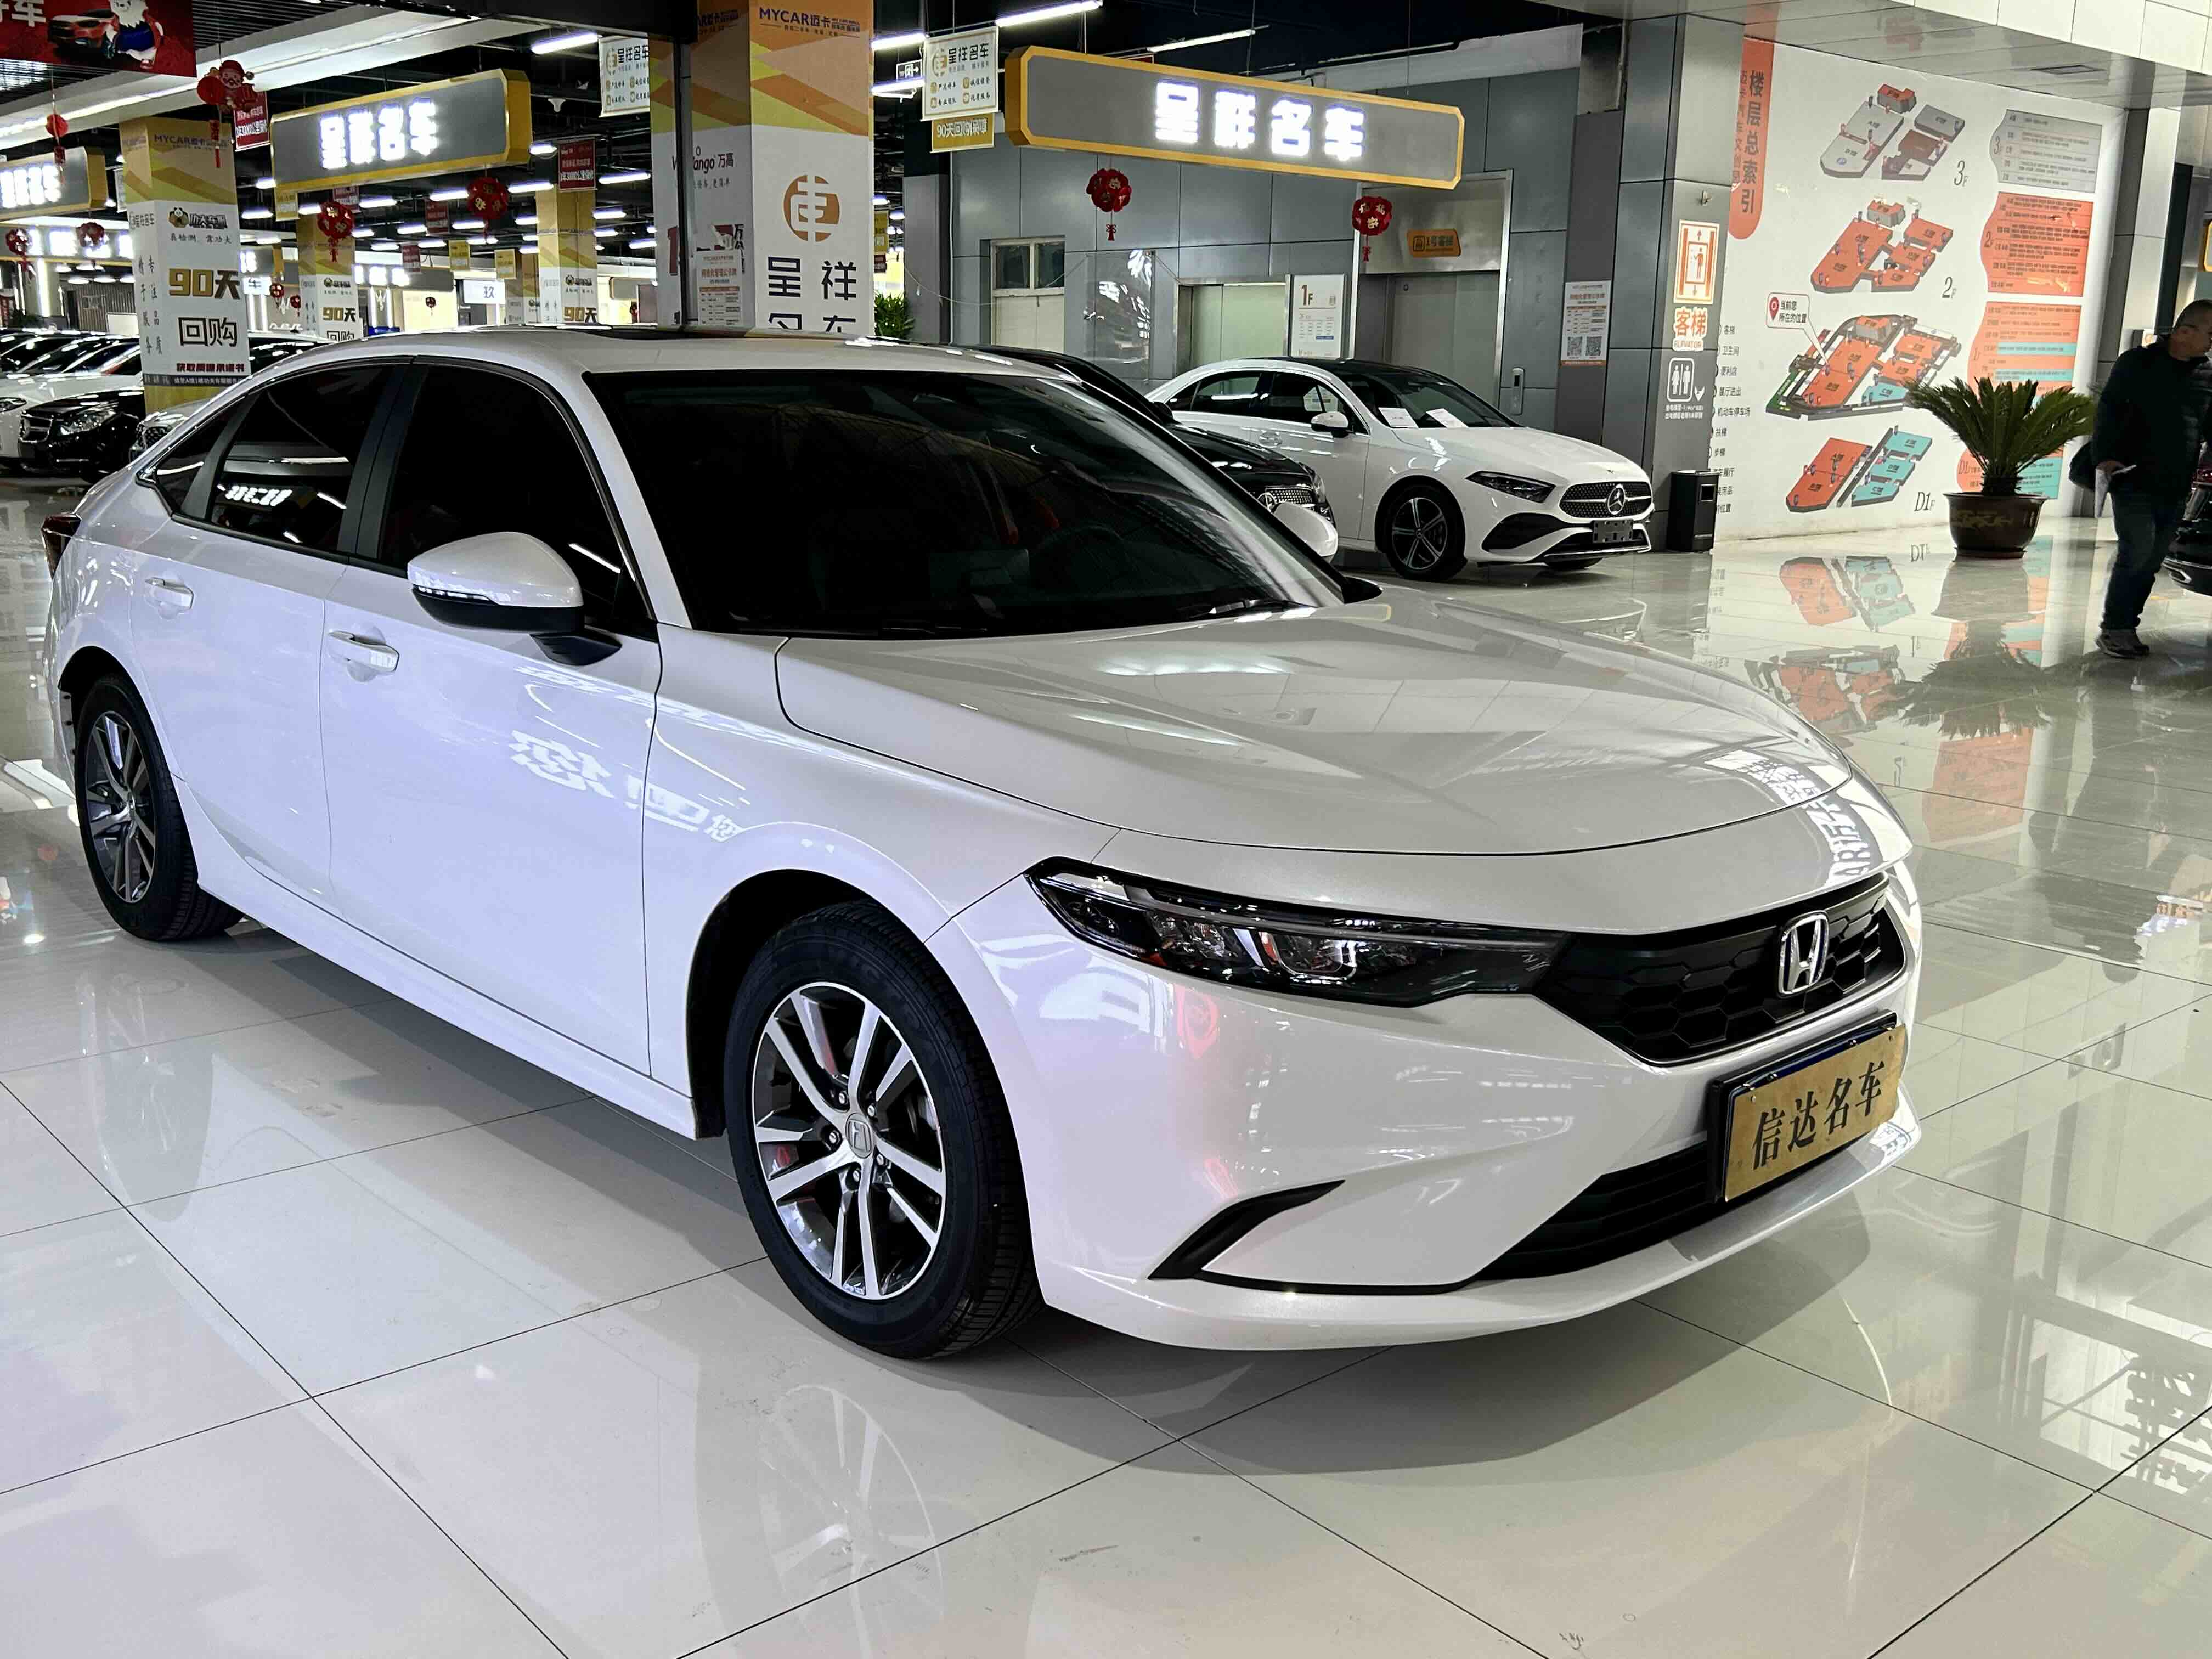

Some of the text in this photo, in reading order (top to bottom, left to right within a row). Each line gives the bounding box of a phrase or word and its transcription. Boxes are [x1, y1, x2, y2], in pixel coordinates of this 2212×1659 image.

[0, 0, 46, 27] 车
[949, 43, 989, 64] 呈祥名车
[1741, 70, 1765, 215] 楼层总索引
[168, 268, 241, 300] 90天
[768, 256, 856, 301] 呈祥
[1301, 285, 1313, 306] 1F
[323, 307, 356, 323] 90天
[563, 306, 597, 323] 90天
[1675, 309, 1707, 337] 客梯
[1778, 312, 1807, 324] 所在的位置
[178, 317, 238, 348] 回购
[1722, 346, 1740, 356] 卫生间
[1720, 366, 1737, 376] 便利店
[1718, 407, 1751, 417] 机动车停车场
[1752, 1060, 1885, 1170] 信达名车
